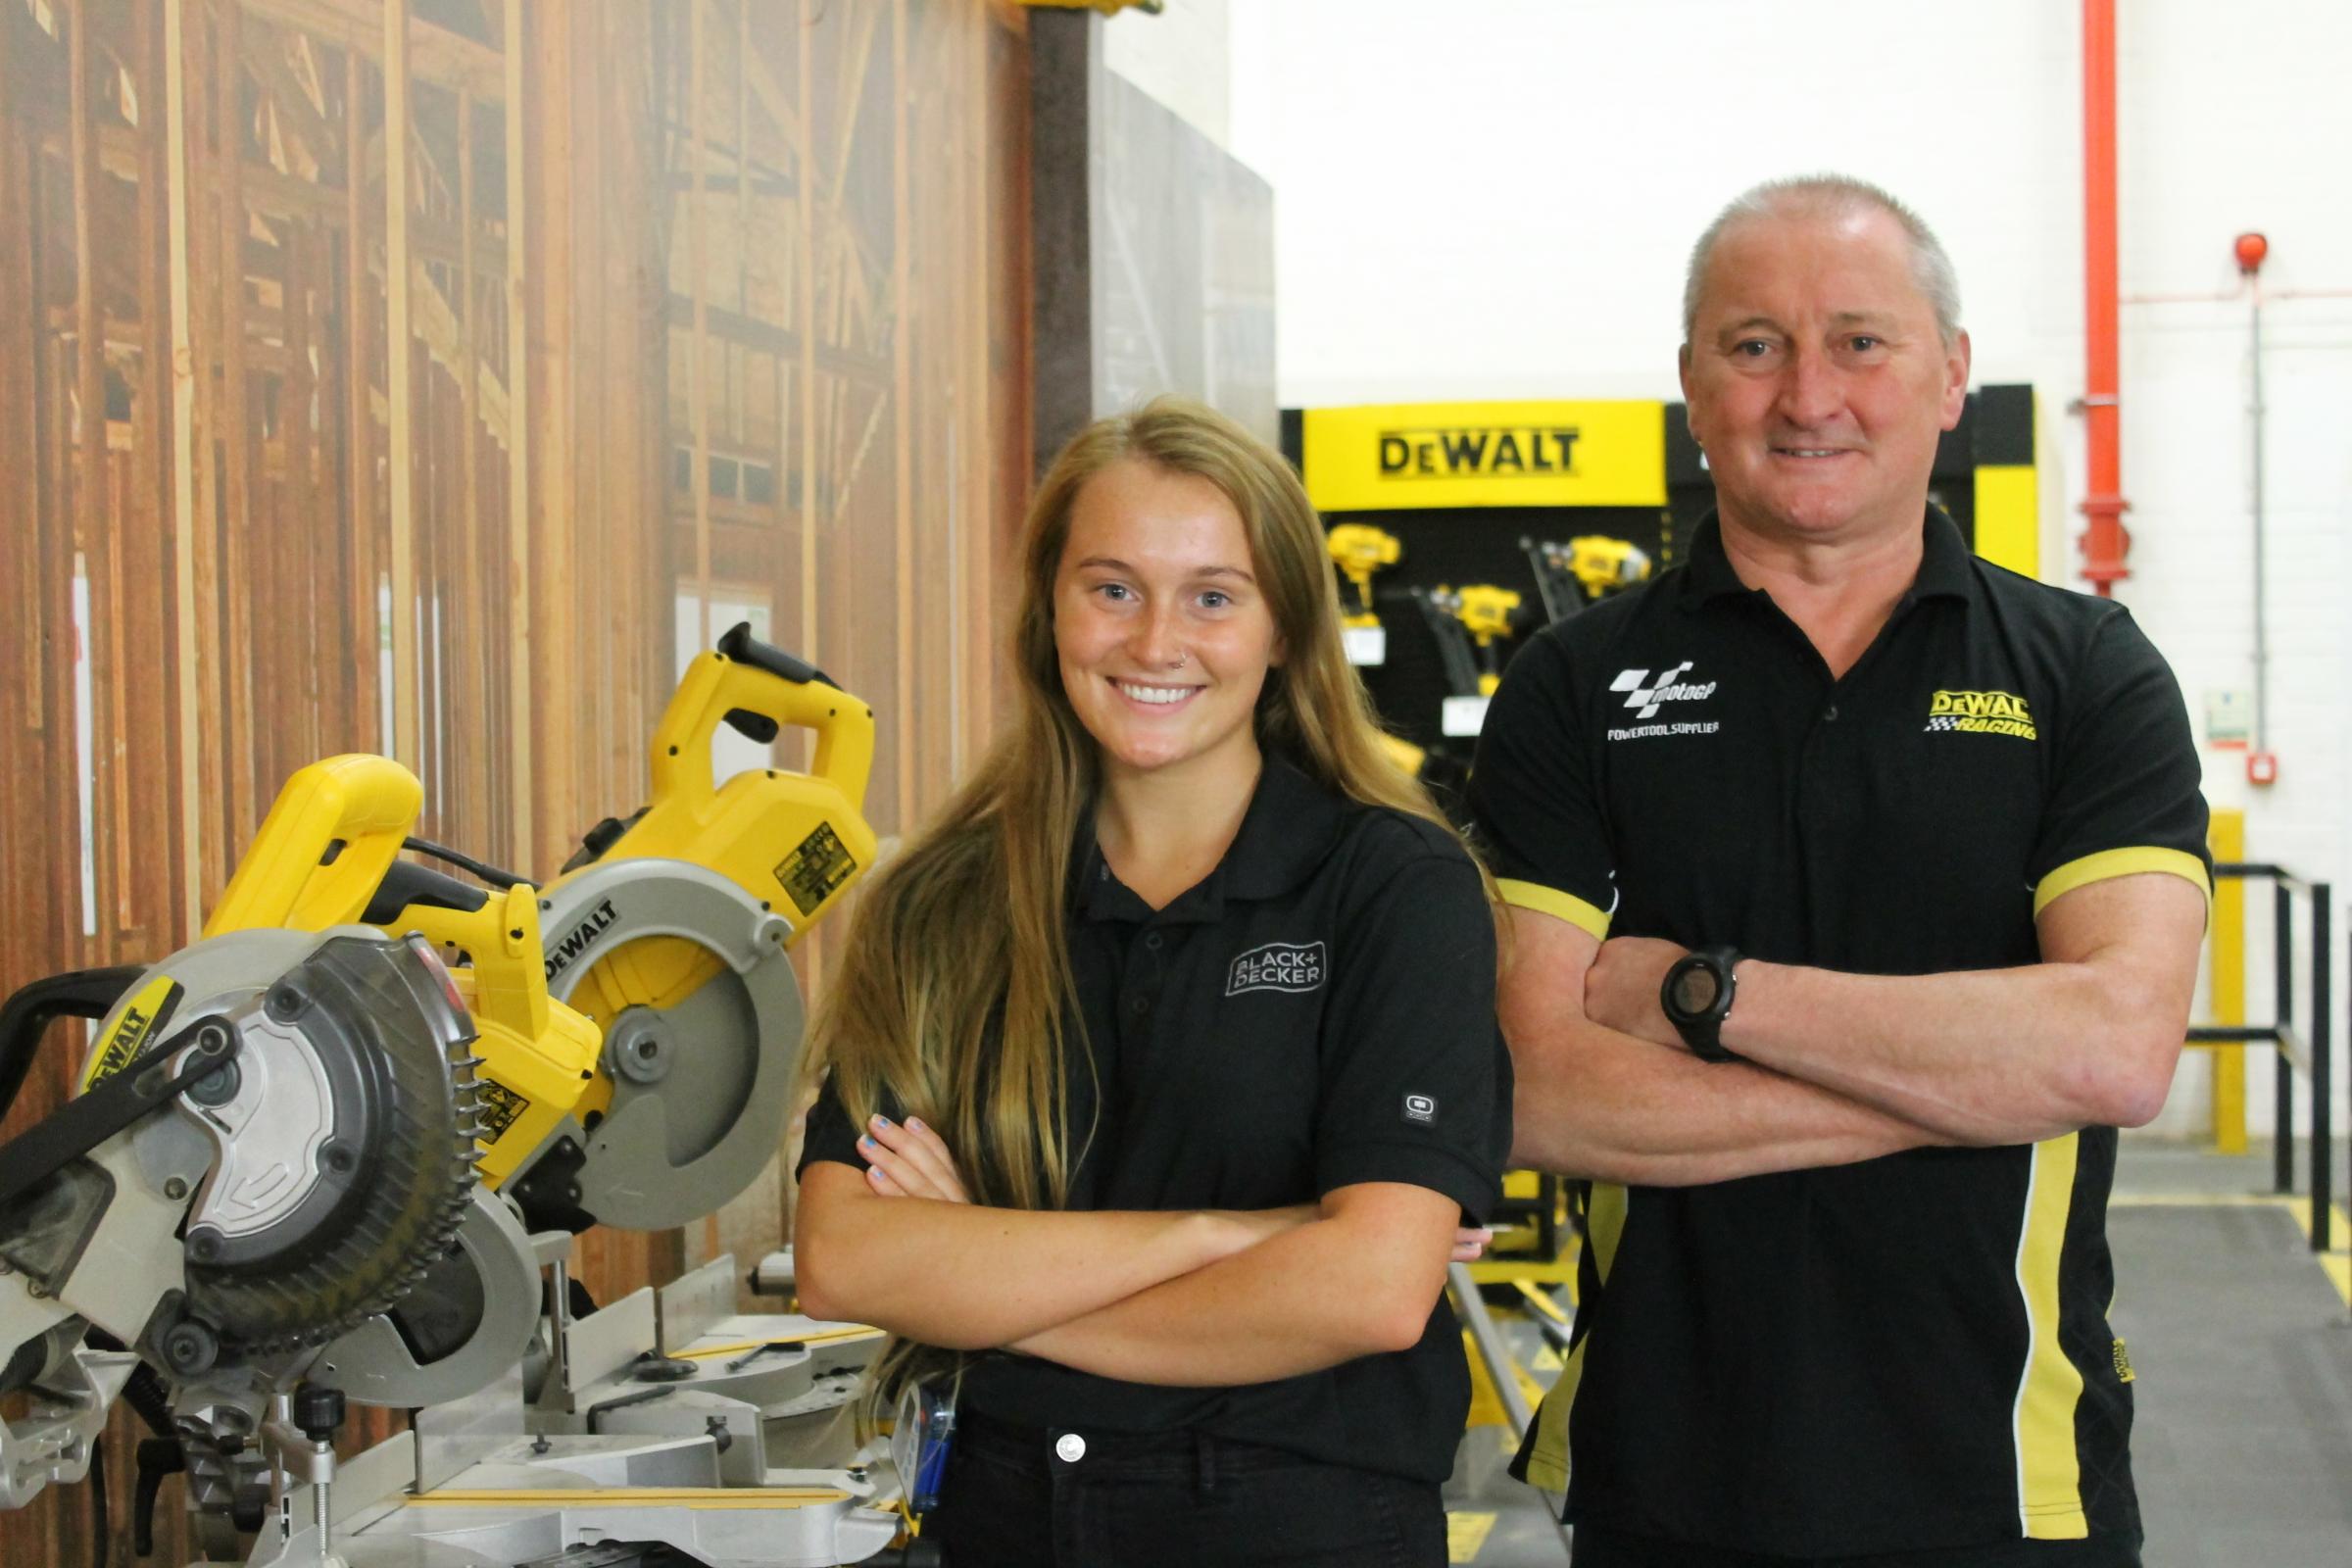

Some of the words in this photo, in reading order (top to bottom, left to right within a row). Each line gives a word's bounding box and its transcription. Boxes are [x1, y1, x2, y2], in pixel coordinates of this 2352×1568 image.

[1931, 693, 2030, 720] DEWAL
[1954, 717, 2036, 741] RACING
[1234, 965, 1320, 989] DECKER
